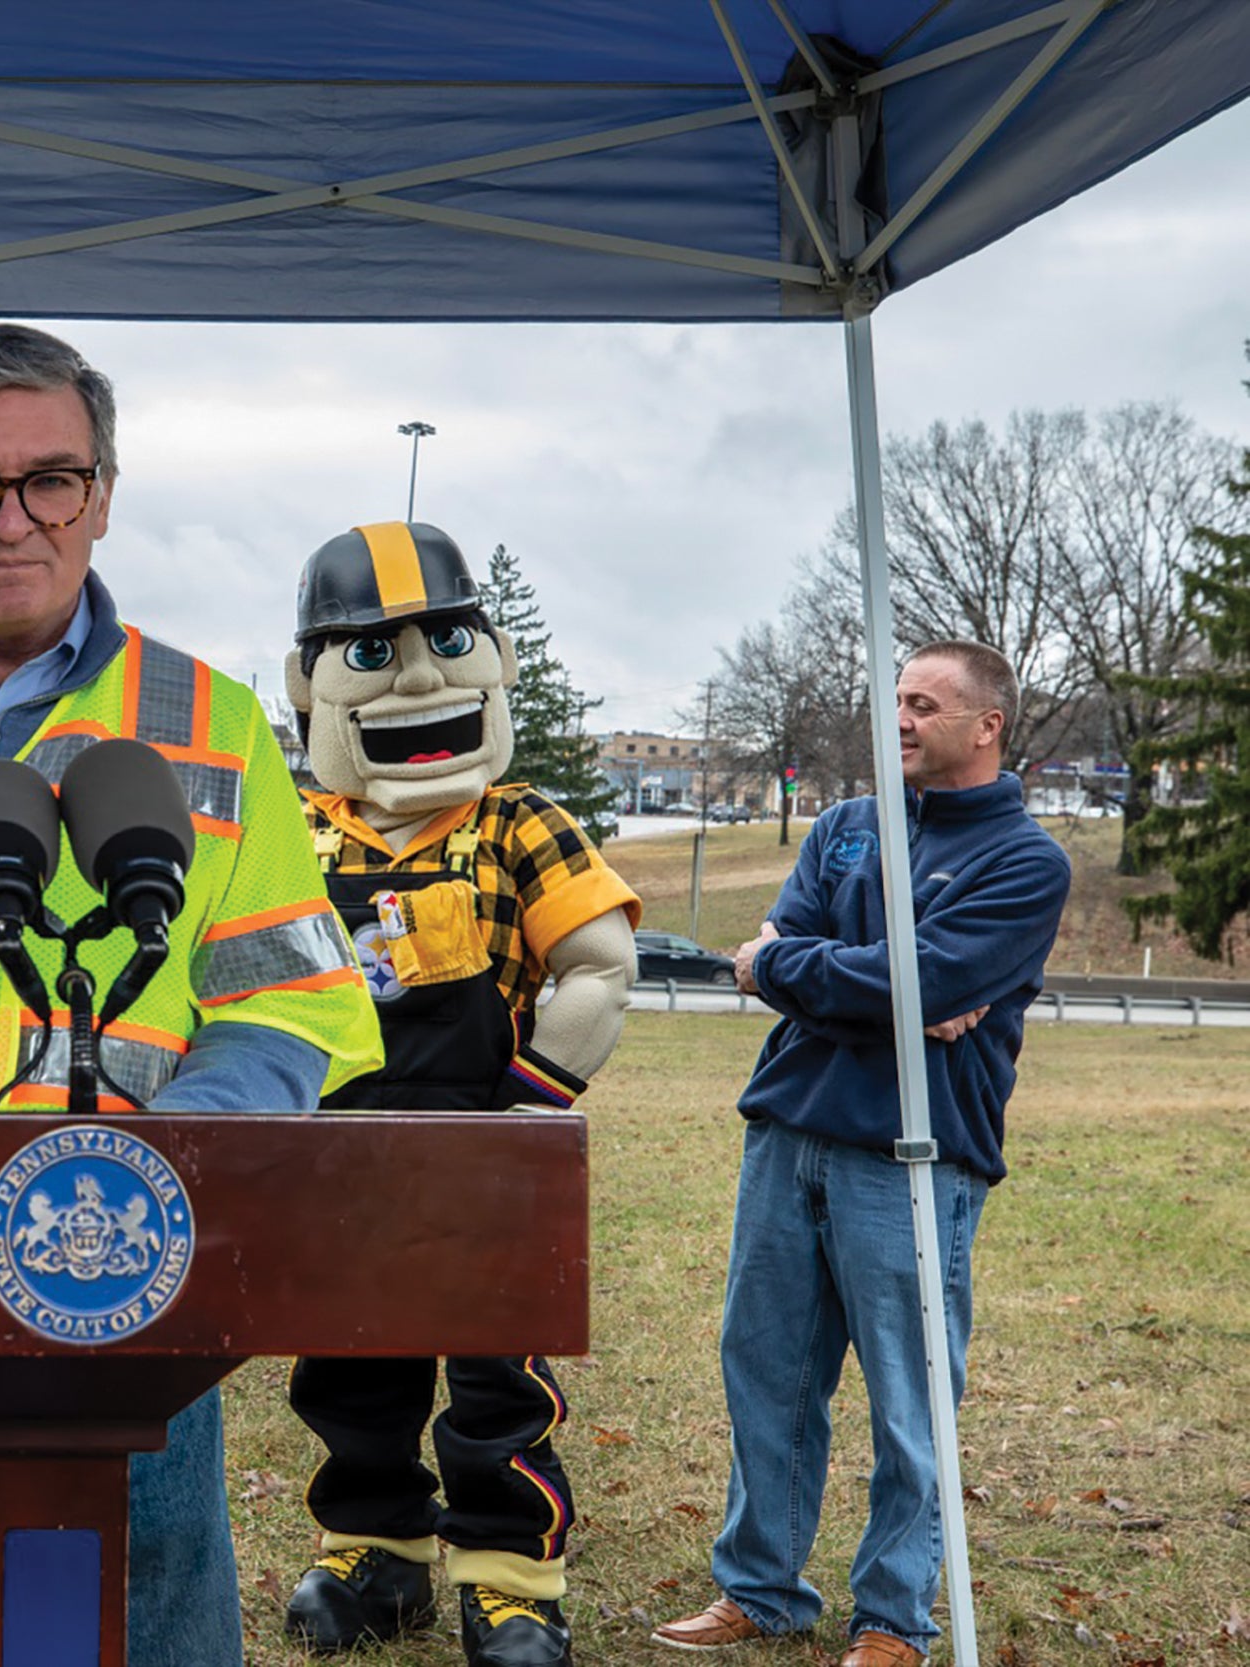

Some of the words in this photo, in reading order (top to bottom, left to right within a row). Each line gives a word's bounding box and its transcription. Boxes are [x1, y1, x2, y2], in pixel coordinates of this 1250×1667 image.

[36, 1309, 106, 1337] COAT
[109, 1303, 144, 1332] OF
[147, 1237, 188, 1309] ARMS
